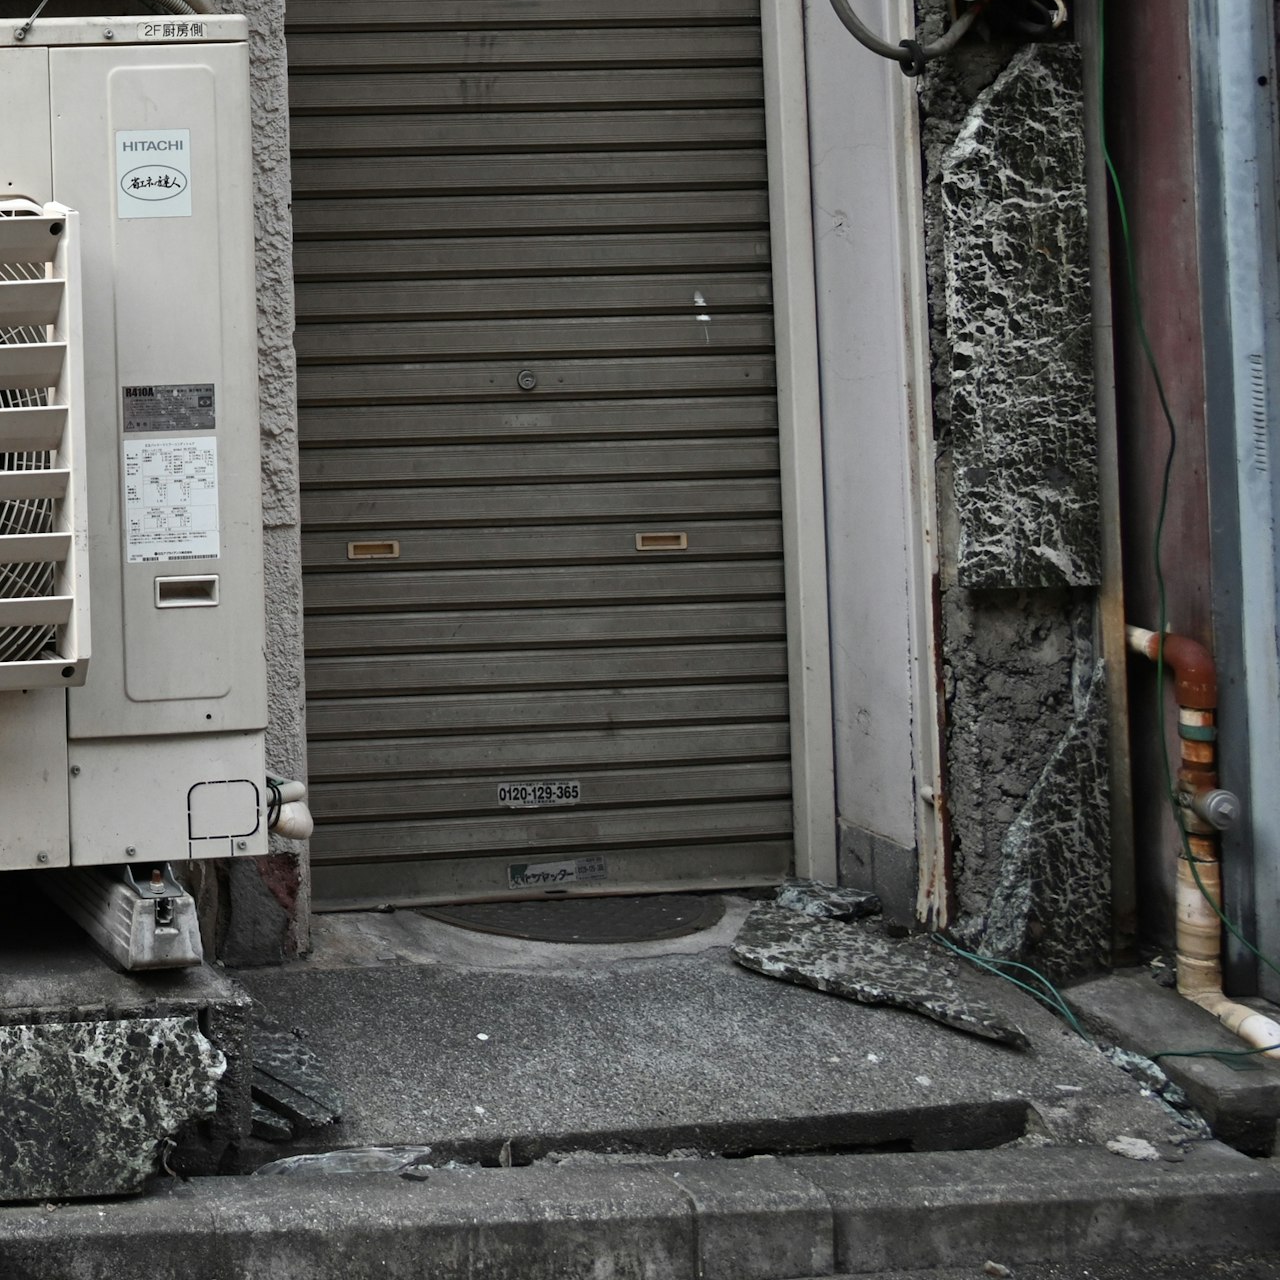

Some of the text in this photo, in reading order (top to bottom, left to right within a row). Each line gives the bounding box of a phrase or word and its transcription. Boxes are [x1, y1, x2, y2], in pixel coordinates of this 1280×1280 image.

[144, 23, 203, 37] 2F厨房側
[122, 140, 183, 152] HITACHI
[127, 174, 181, 190] 省エネの達人
[125, 387, 154, 398] R410A
[499, 785, 579, 801] 0120-129-365
